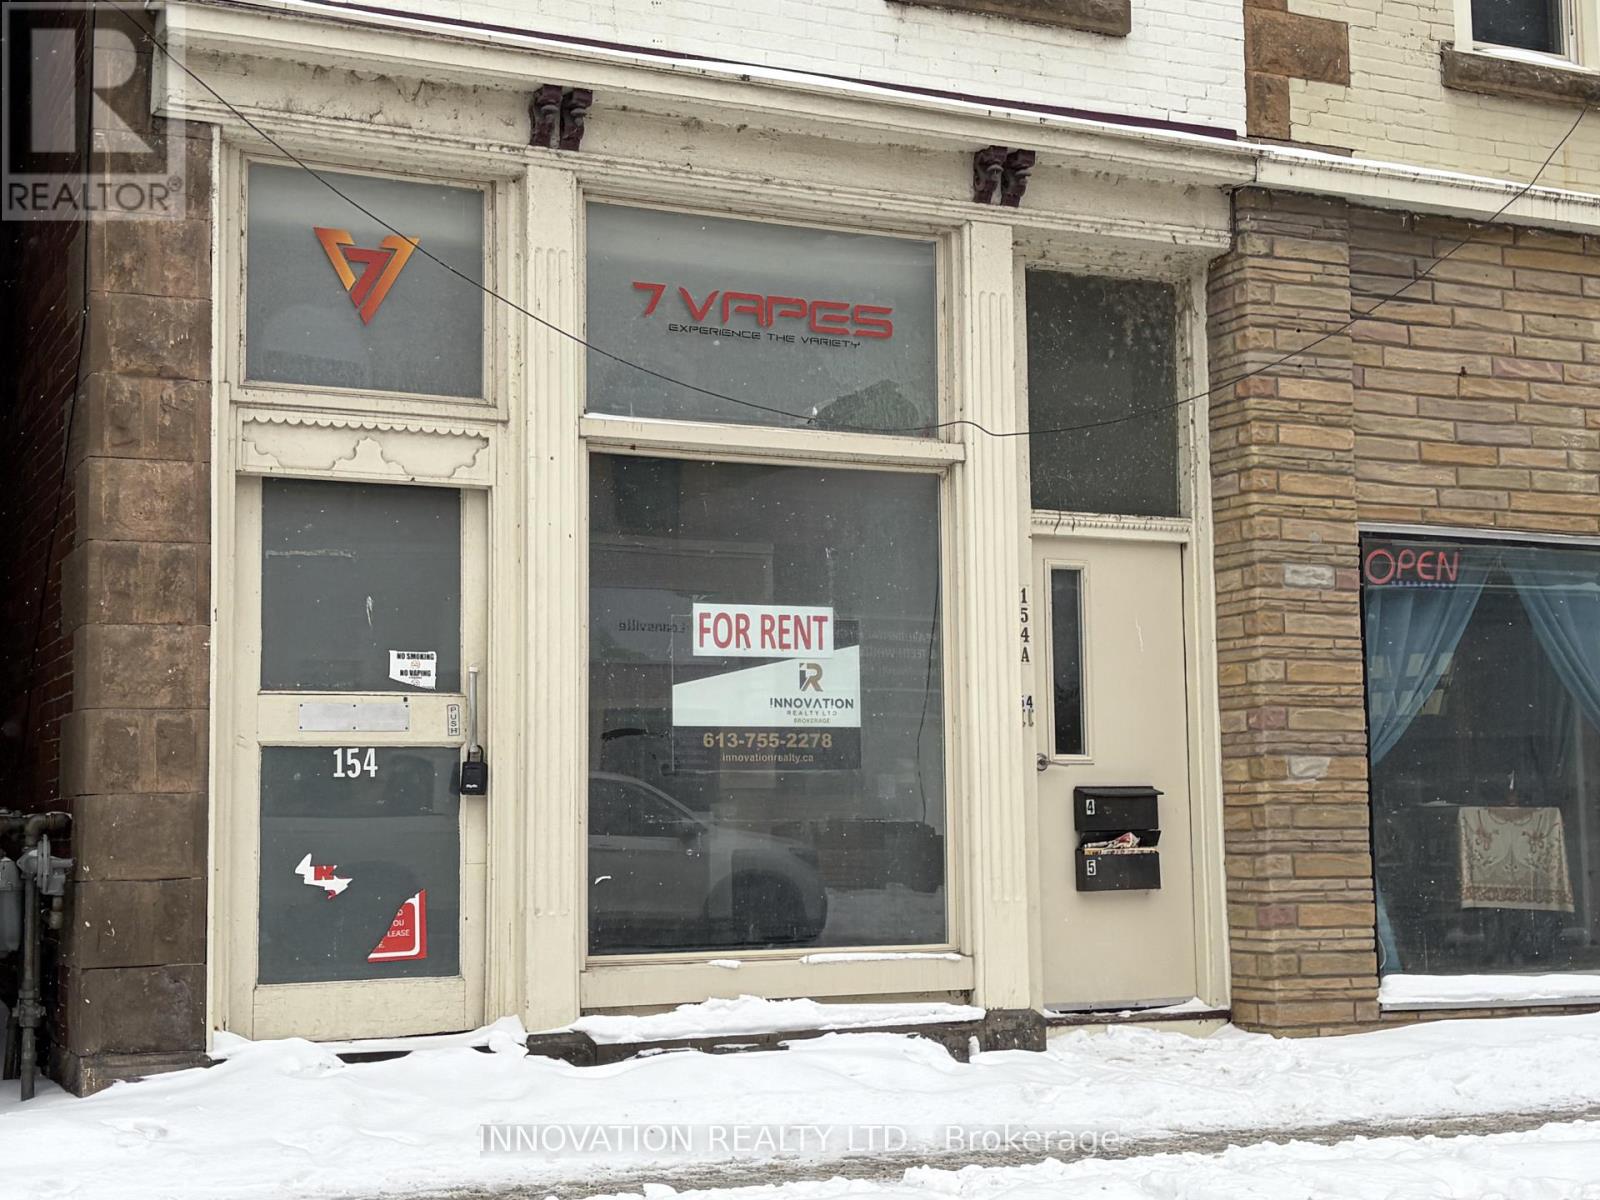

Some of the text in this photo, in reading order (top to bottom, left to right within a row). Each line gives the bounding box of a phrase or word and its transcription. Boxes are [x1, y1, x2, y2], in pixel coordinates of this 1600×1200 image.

[632, 281, 894, 339] 7 VAPES
[668, 323, 861, 349] EXPERIENCE THE VARIETY
[1364, 548, 1459, 585] OPEN
[698, 612, 751, 649] FOR
[760, 614, 829, 651] RENT
[397, 652, 435, 661] NO SMOKING
[400, 669, 431, 677] NO VAPING
[769, 697, 854, 709] INNOVATION
[450, 706, 458, 734] PUSH
[702, 732, 833, 748] 613-755-2278
[333, 747, 378, 778] 154
[1087, 800, 1095, 814] 4
[1088, 860, 1096, 874] 5
[392, 919, 405, 927] OU
[387, 928, 411, 938] LEASE
